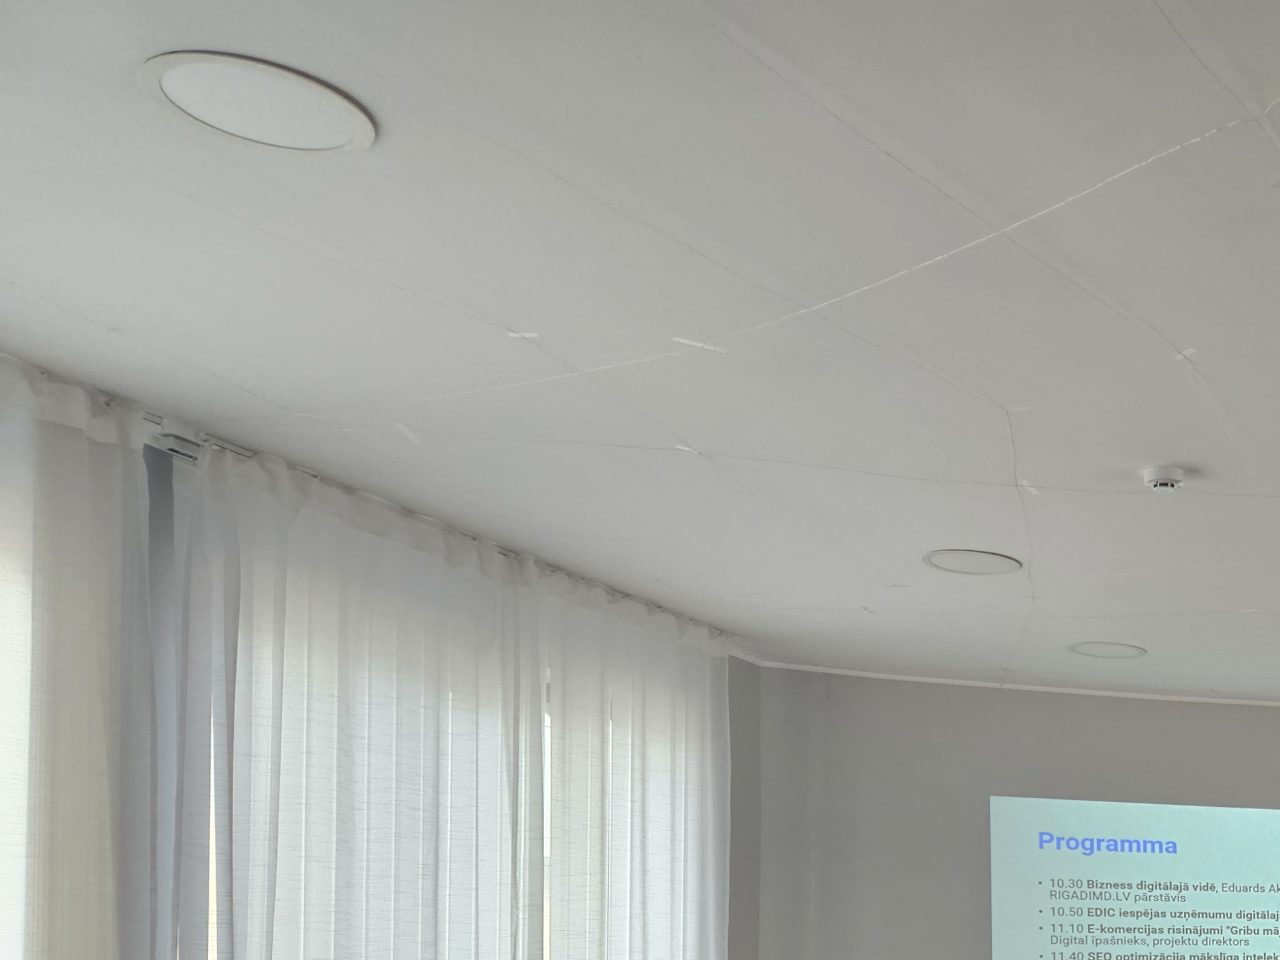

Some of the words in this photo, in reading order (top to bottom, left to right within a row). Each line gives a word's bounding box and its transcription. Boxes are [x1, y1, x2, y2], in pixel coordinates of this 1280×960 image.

[1038, 832, 1178, 856] Programma
[1050, 879, 1083, 889] 10.30
[1087, 880, 1133, 890] Bizness
[1136, 880, 1190, 893] digitālajā
[1192, 883, 1219, 893] vidē,
[1222, 883, 1265, 893] Eduards
[1050, 890, 1131, 901] RIGADIMD.LV
[1134, 893, 1186, 903] pārstāvis
[1051, 907, 1084, 916] 10.50
[1088, 908, 1116, 917] EDIC
[1119, 909, 1167, 920] iespējas
[1170, 910, 1233, 922] uzņēmumu
[1051, 924, 1084, 933] 11.10
[1088, 924, 1164, 936] E-komercijas
[1168, 925, 1223, 937] risinājumi
[1051, 935, 1088, 946] Digital
[1092, 936, 1149, 947] īpašnieks,
[1153, 937, 1198, 947] projektu
[1202, 937, 1250, 946] direktors
[1051, 952, 1084, 960] 11.40
[1088, 952, 1112, 960] SEO
